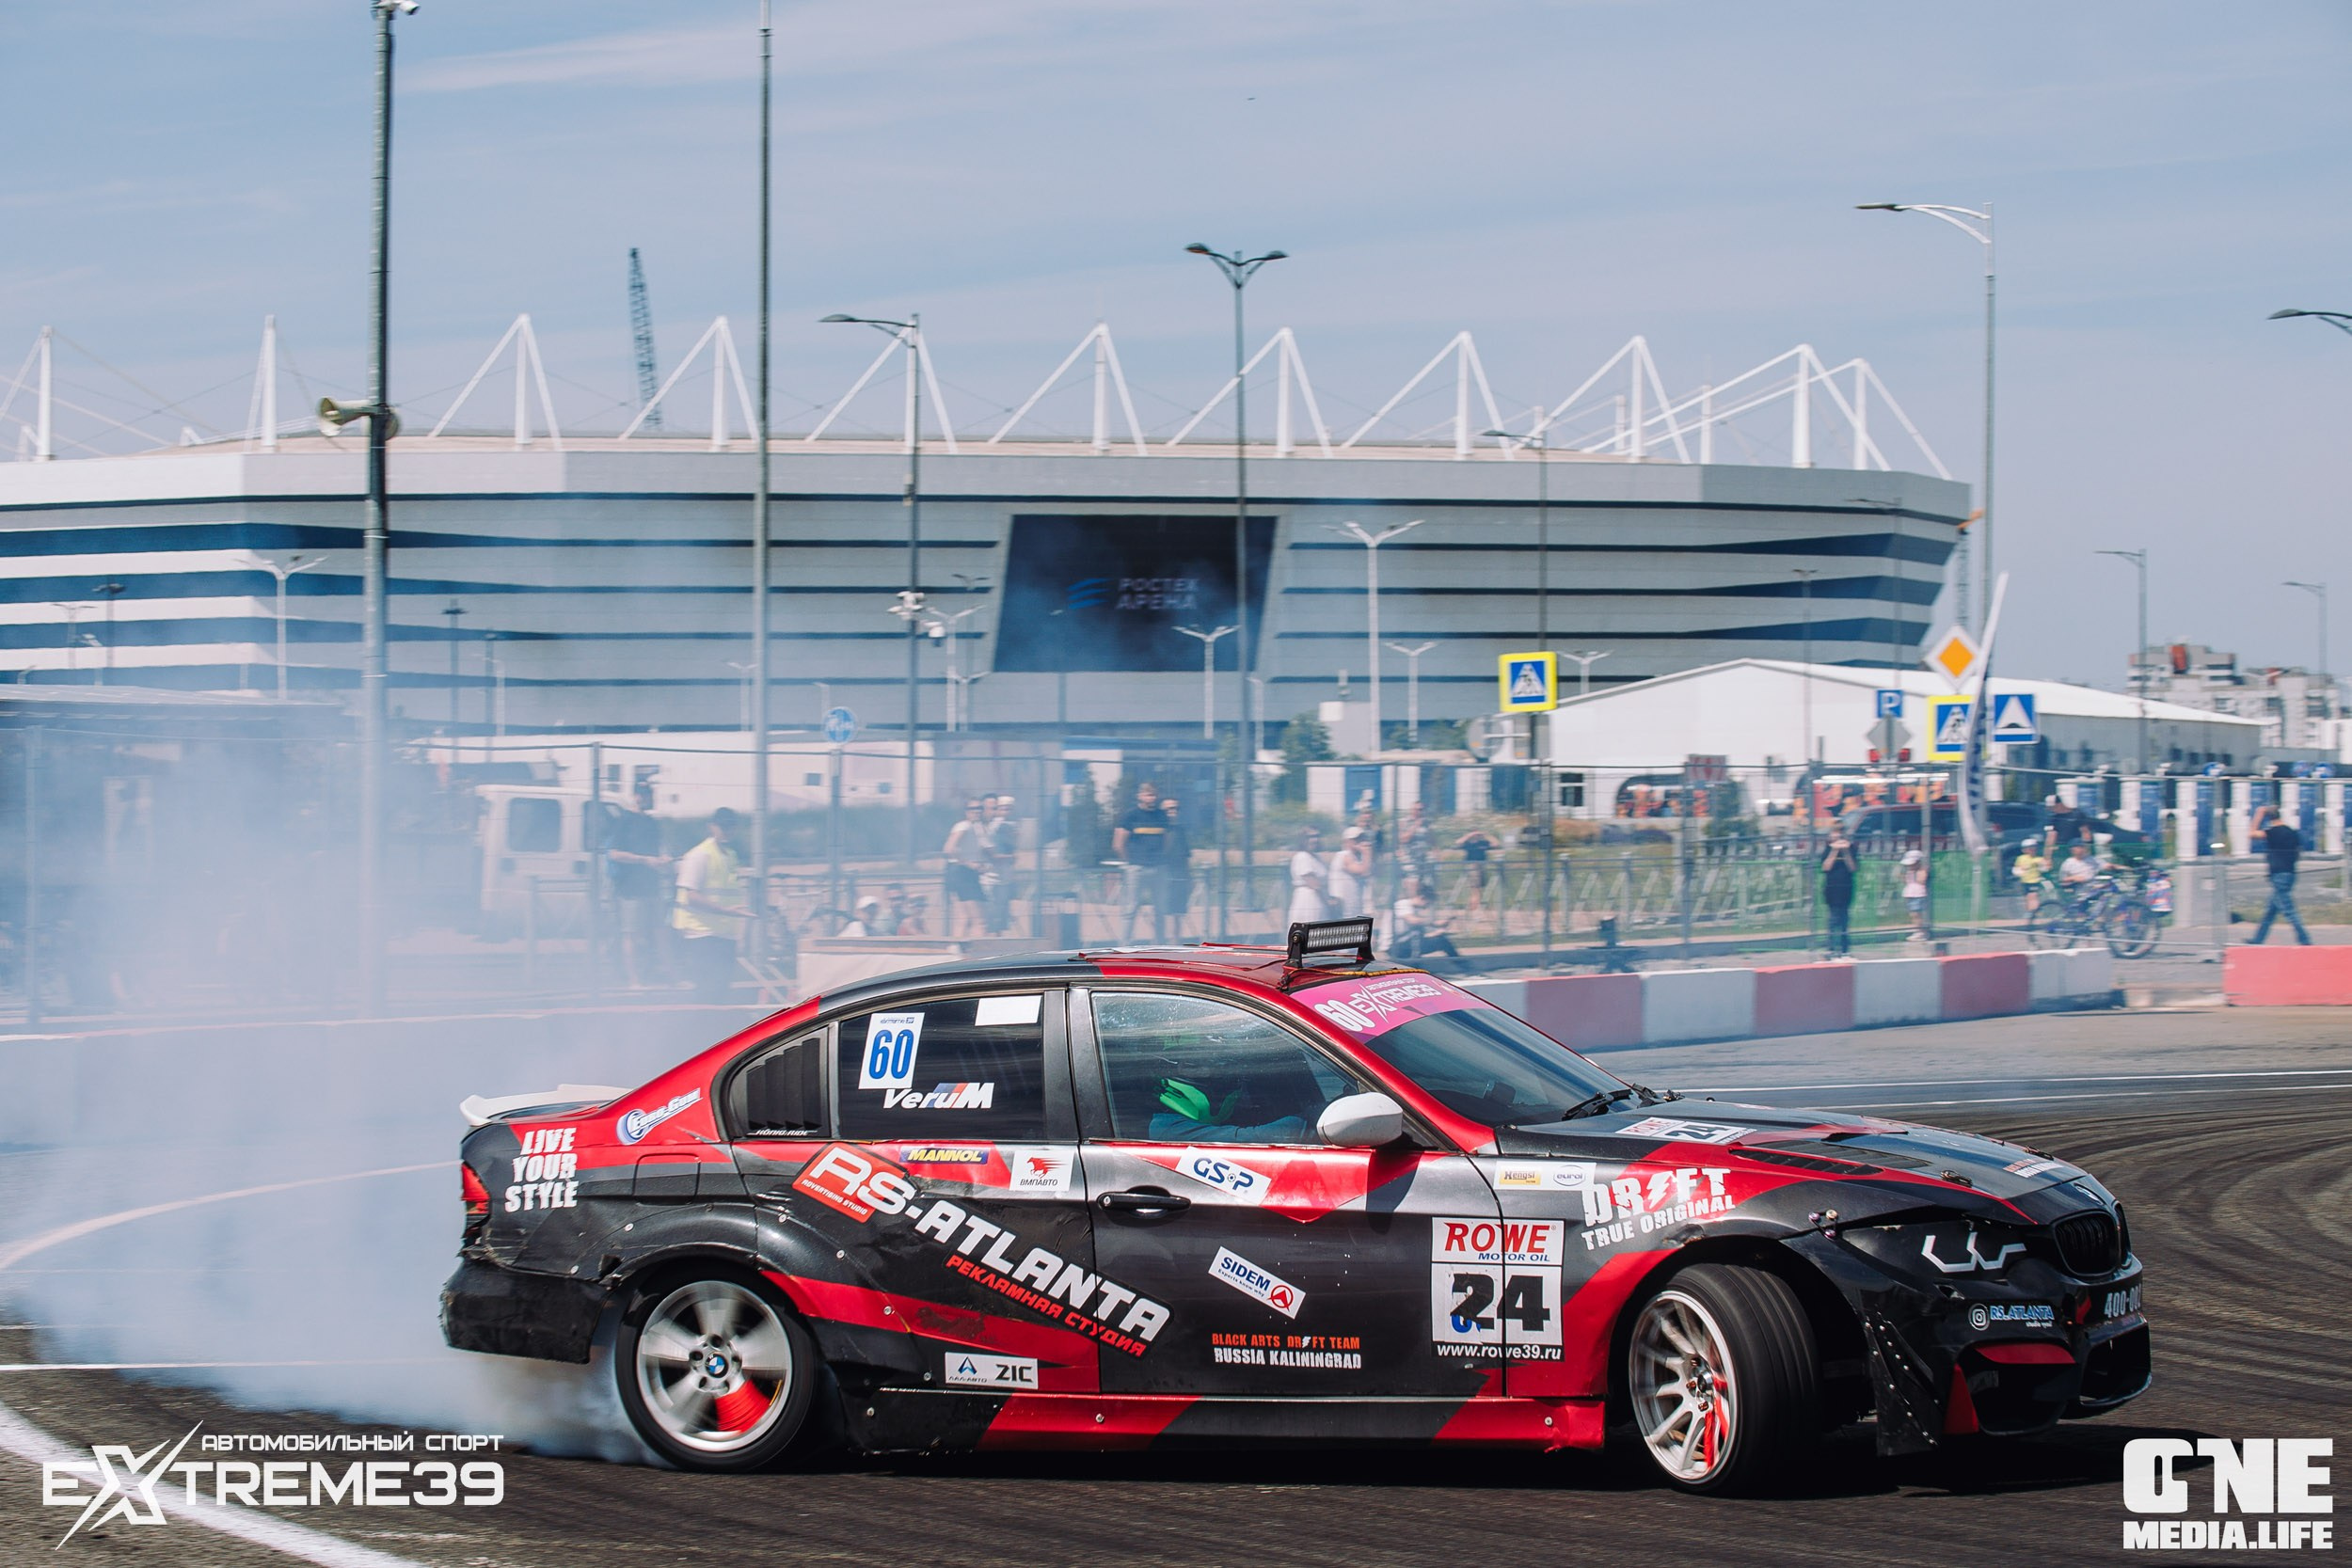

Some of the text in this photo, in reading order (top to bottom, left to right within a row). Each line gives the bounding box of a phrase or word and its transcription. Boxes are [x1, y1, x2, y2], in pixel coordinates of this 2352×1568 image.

[1115, 594, 1197, 610] АРЕНА
[1314, 999, 1375, 1032] 60
[868, 1029, 914, 1080] 60
[883, 1083, 994, 1109] VeruM
[520, 1128, 577, 1155] LIVE
[908, 1148, 983, 1163] MANNOL
[513, 1153, 578, 1182] YOUR
[504, 1180, 579, 1212] STYLE
[801, 1179, 867, 1215] ADVERTISING STUDIO
[1020, 1179, 1058, 1187] ВМПАВТО
[1581, 1195, 1736, 1251] TRUE ORIGINAL
[1444, 1222, 1550, 1253] ROWE
[1478, 1253, 1526, 1261] MOTOR
[1221, 1257, 1271, 1291] SIDEM
[946, 1255, 1146, 1357] РЕКЛАМНАЯ СТУДИЯ
[1450, 1273, 1550, 1332] 24
[1212, 1333, 1247, 1346] BLACK
[1251, 1334, 1280, 1348] ARTS
[1329, 1337, 1359, 1349] TEAM
[1437, 1344, 1562, 1360] www.rowe39.ru
[1214, 1347, 1361, 1369] RUSSIA KALININGRAD
[995, 1364, 1033, 1383] ZIC
